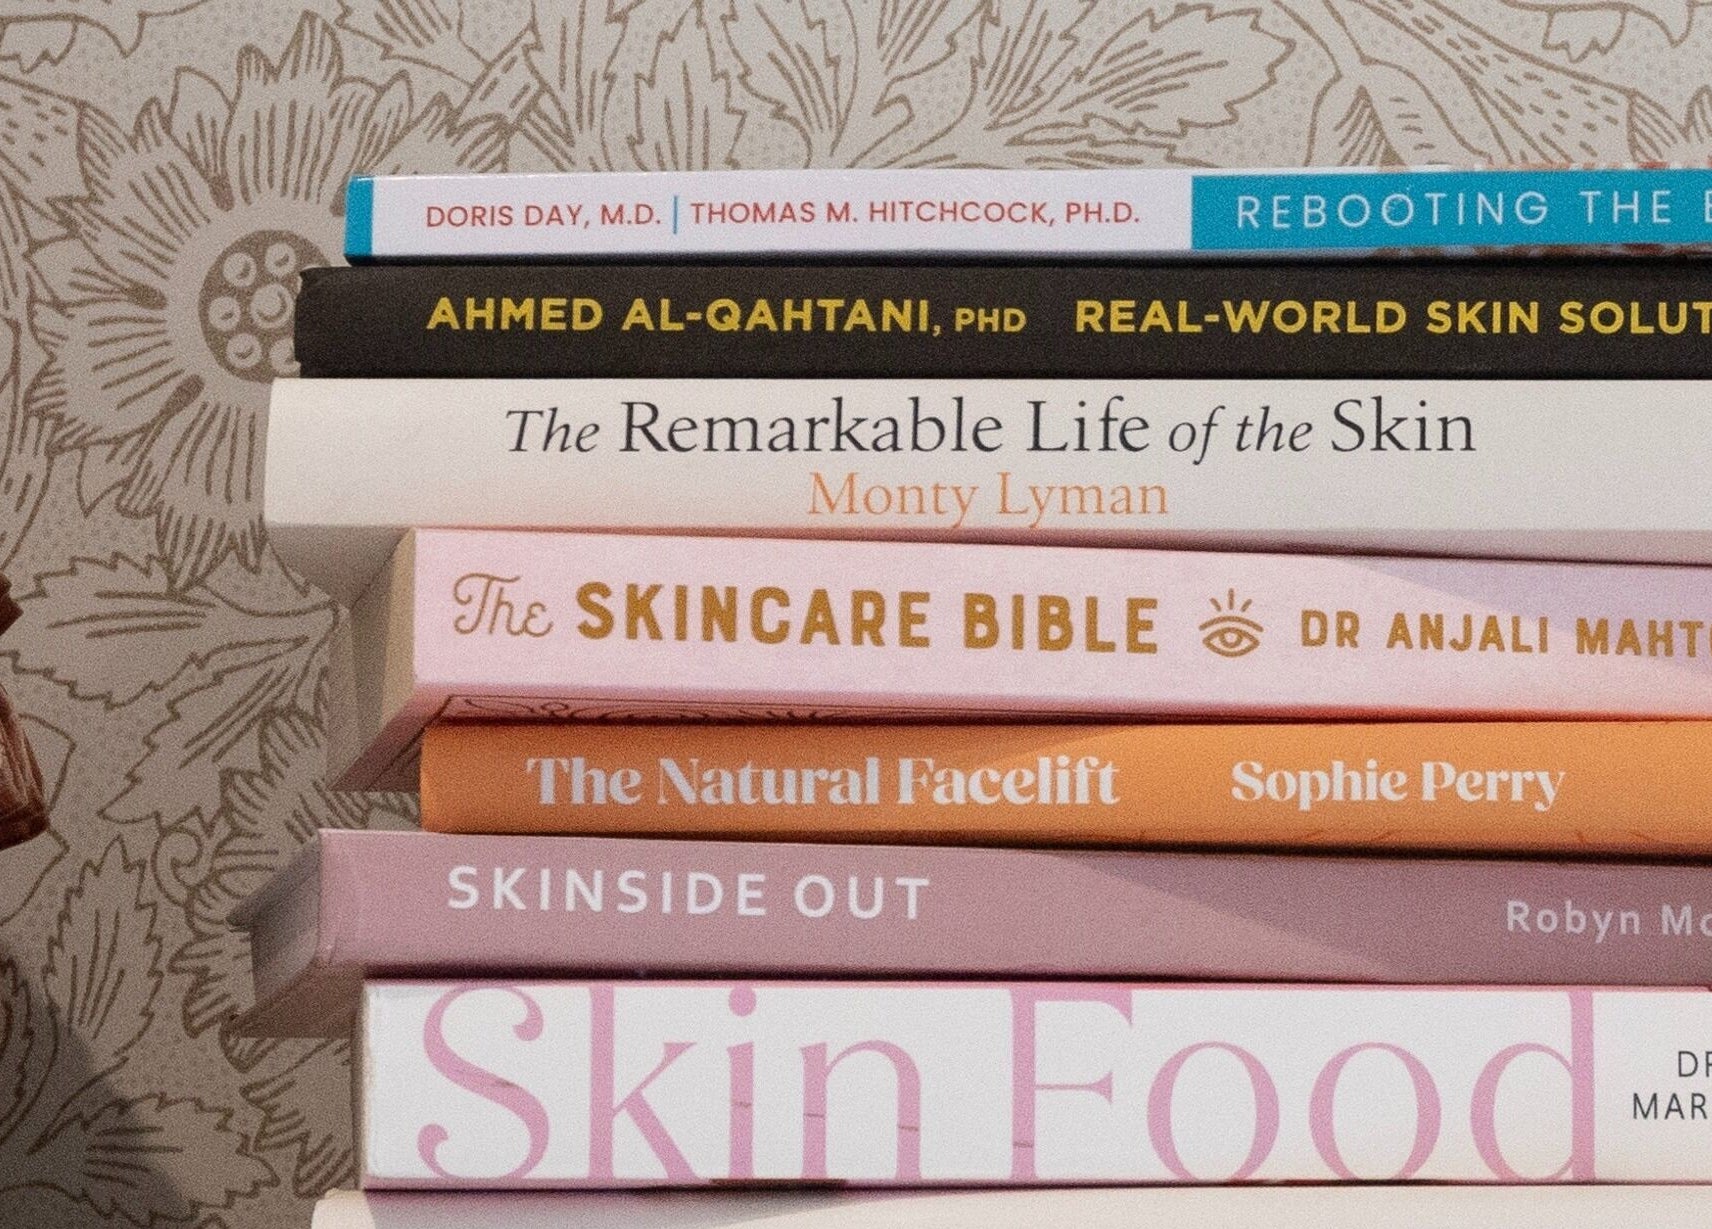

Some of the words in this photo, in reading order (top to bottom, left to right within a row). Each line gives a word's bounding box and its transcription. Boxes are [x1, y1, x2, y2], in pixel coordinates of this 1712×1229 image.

[426, 203, 517, 228] DORIS
[524, 203, 591, 229] DAY,
[601, 202, 661, 226] M.D.
[691, 200, 815, 225] THOMAS
[826, 200, 859, 224] M.
[870, 200, 1055, 227] HITCHCOCK,
[1066, 200, 1140, 224] PH.D.
[1237, 192, 1548, 229] REBOOTING
[1579, 190, 1670, 224] THE
[427, 298, 602, 331] AHMED
[622, 298, 942, 337] AL-QAHTANI,
[955, 307, 1027, 332] PHD
[1076, 300, 1407, 333] REAL-WORLD
[1426, 300, 1540, 333] SKIN
[506, 407, 600, 454] The
[619, 395, 1002, 454] Remarkable
[1026, 394, 1149, 453] Life
[1169, 405, 1225, 465] of
[1235, 406, 1313, 453] the
[1332, 397, 1476, 453] Skin
[809, 471, 977, 528] Monty
[1000, 472, 1169, 531] Lyman
[453, 572, 554, 638] The
[576, 580, 931, 647] SKINCARE
[963, 592, 1158, 654] BIBLE
[1302, 609, 1360, 649] DR
[1386, 613, 1549, 654] ANJALI
[527, 756, 642, 805] The
[658, 756, 878, 806] Natural
[896, 755, 1121, 806] Facelift
[1232, 759, 1409, 812] Sophie
[1421, 761, 1566, 813] Perry
[448, 865, 767, 915] SKINSIDE
[795, 874, 930, 920] OUT
[1508, 900, 1640, 941] Robyn
[417, 982, 922, 1181] Skin
[1006, 984, 1595, 1182] Food
